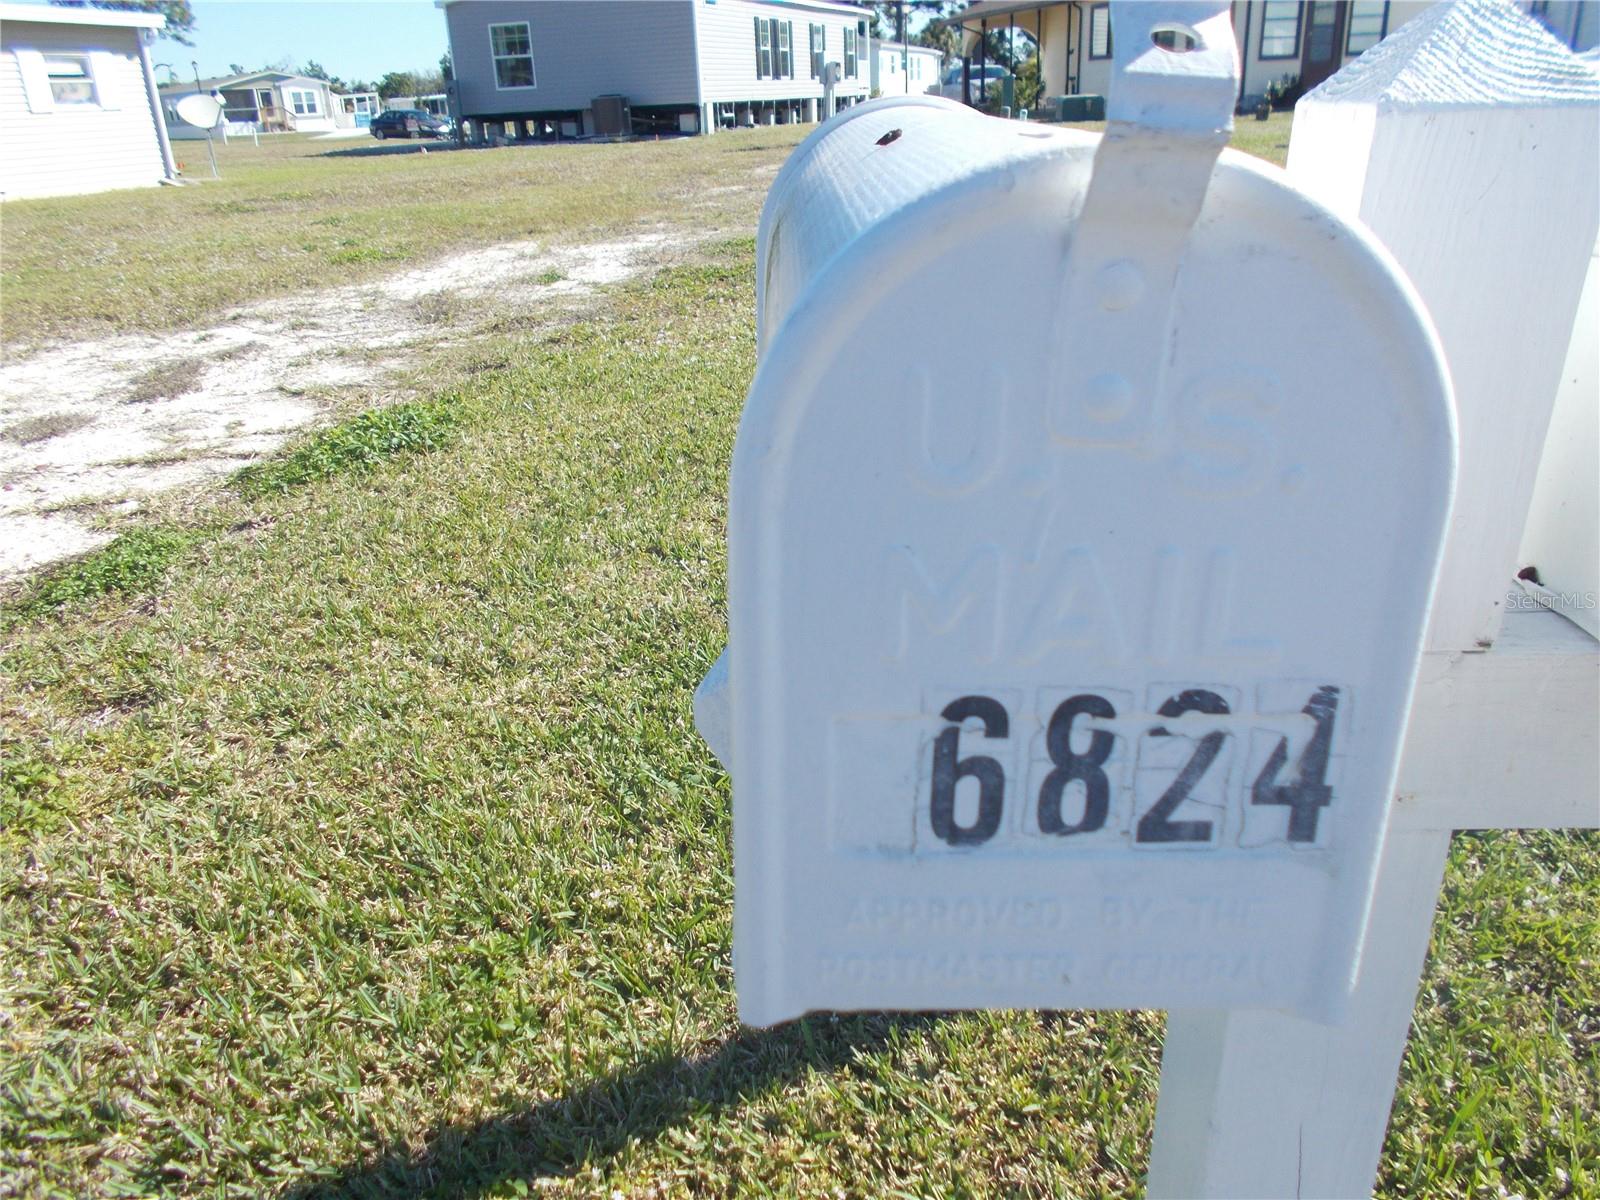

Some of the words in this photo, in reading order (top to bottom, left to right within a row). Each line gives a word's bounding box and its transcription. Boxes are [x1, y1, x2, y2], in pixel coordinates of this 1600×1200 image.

[880, 542, 1284, 668] MAIL
[929, 685, 1340, 847] 6824
[845, 896, 1066, 933] APPROVED
[1098, 896, 1154, 933] BY
